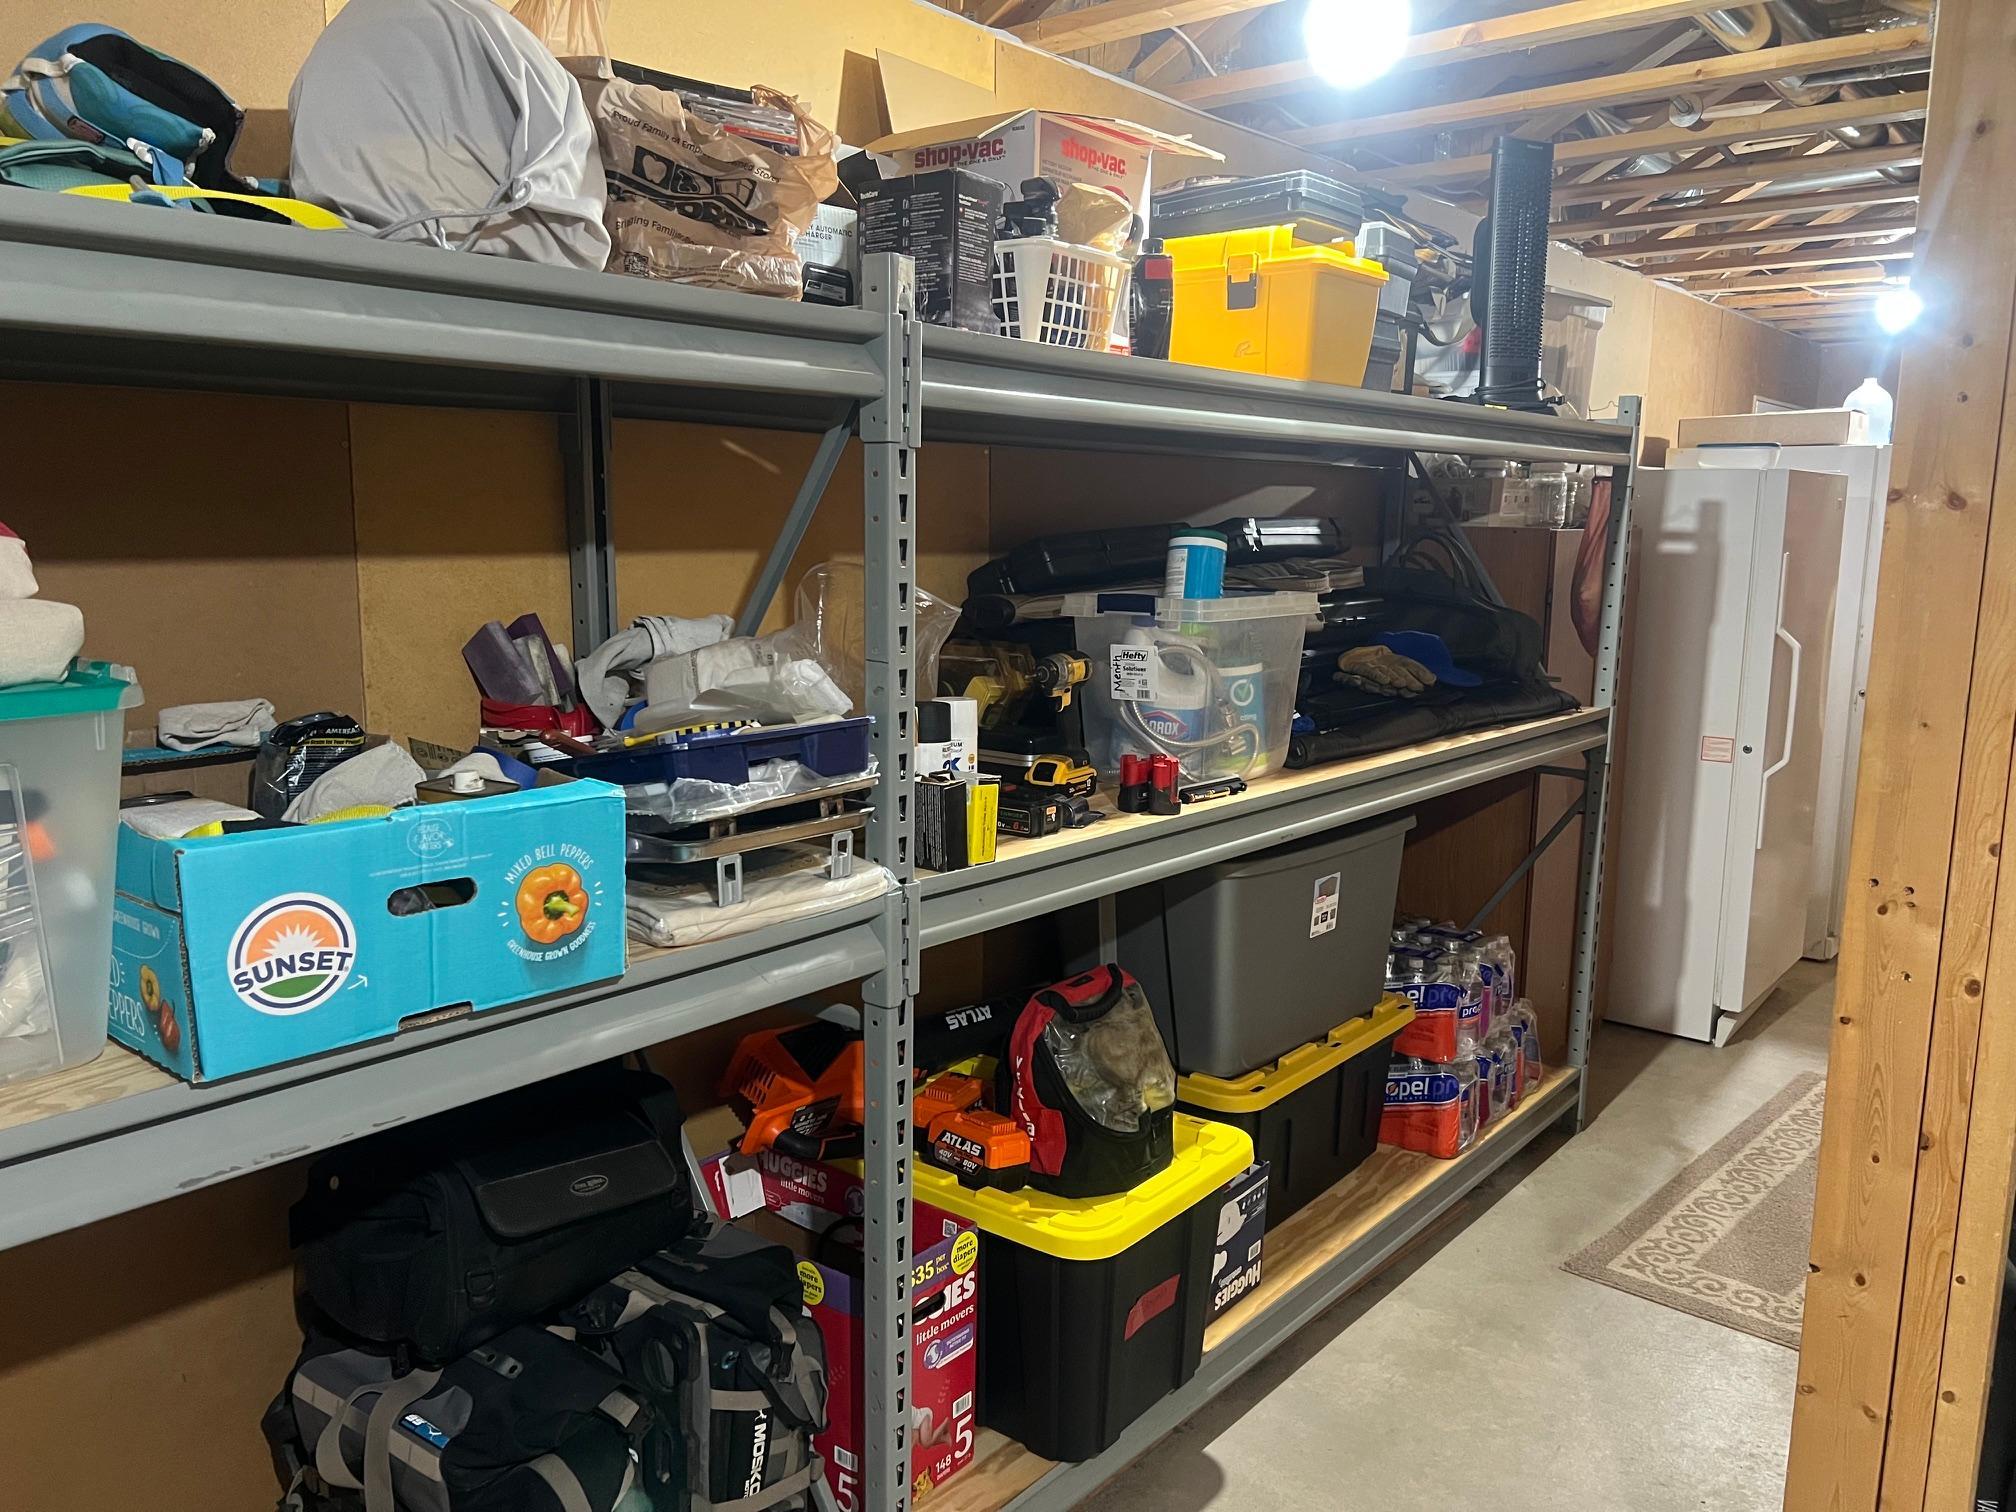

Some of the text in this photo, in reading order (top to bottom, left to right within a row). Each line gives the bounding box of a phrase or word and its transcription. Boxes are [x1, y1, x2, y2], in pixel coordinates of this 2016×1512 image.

[613, 110, 641, 128] Proud
[642, 122, 669, 141] Family
[671, 136, 681, 147] of
[806, 231, 833, 240] HARGER
[816, 225, 853, 238] AUTOMATIC
[1122, 651, 1146, 661] Hefty
[1147, 719, 1179, 736] OROX
[504, 854, 532, 885] MIXED
[534, 843, 556, 861] BELL
[560, 843, 594, 870] PEPPERS
[507, 921, 596, 961] GREENHOUSE GROWN GOODNESS
[234, 950, 353, 993] SUNSET
[109, 989, 145, 1037] EPPERS
[945, 1005, 992, 1030] ATLAS
[1385, 1077, 1430, 1100] opel
[941, 1132, 982, 1157] ATLAS
[780, 1180, 797, 1193] little
[953, 1246, 976, 1263] diapers
[956, 1240, 973, 1253] more
[1214, 1259, 1261, 1311] HUGGIES
[916, 1324, 939, 1346] little
[940, 1304, 974, 1330] movers
[955, 1413, 973, 1459] 5
[749, 1422, 767, 1498] MOSKO
[935, 1454, 952, 1473] 148
[837, 1471, 860, 1512] 5
